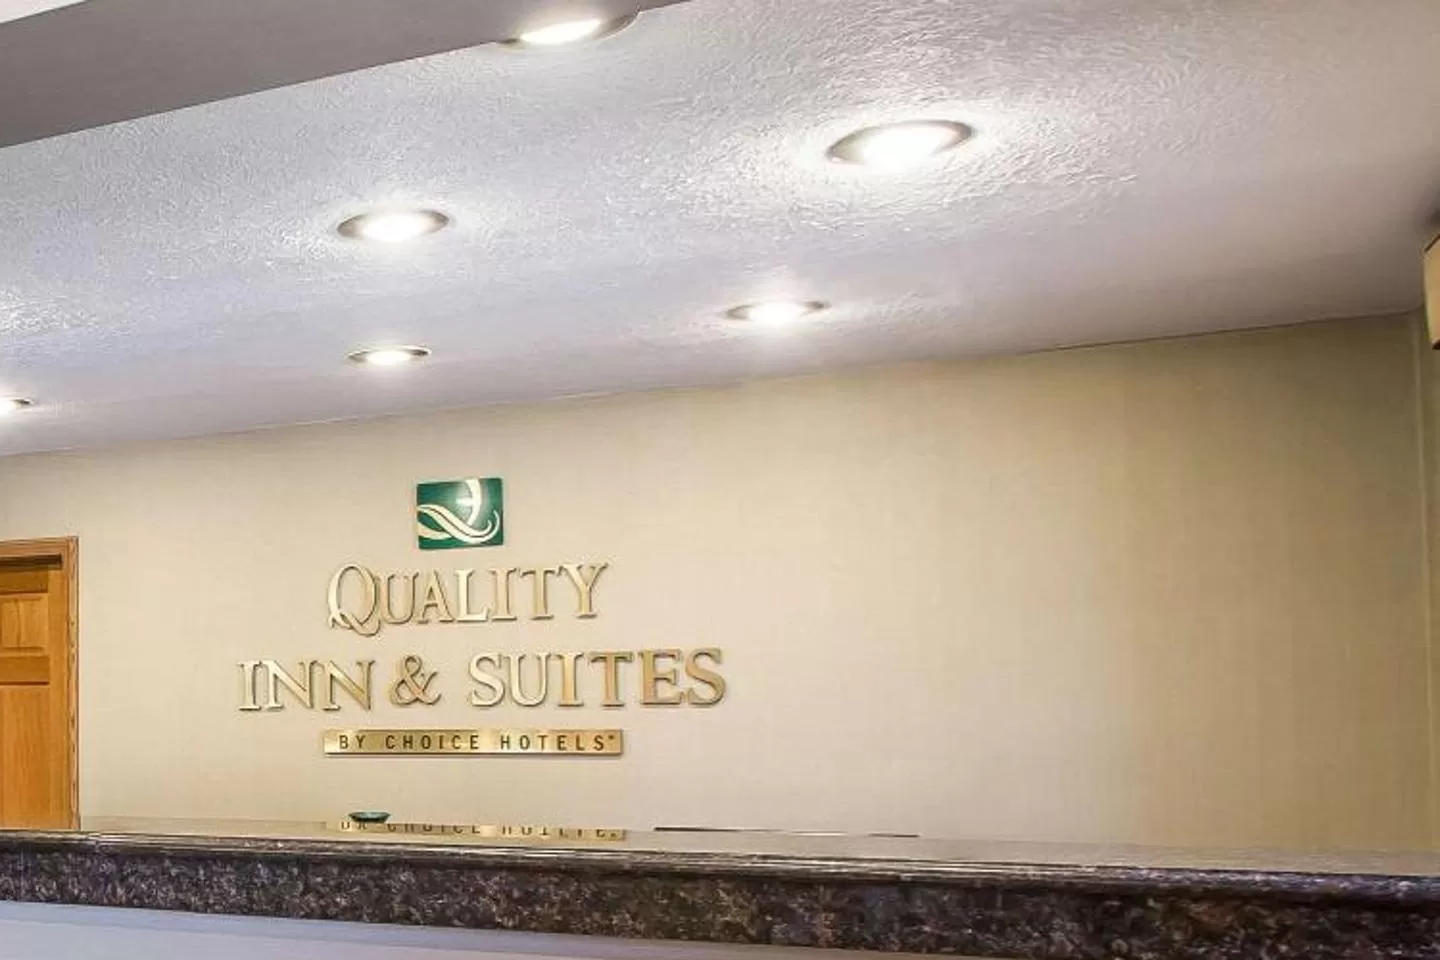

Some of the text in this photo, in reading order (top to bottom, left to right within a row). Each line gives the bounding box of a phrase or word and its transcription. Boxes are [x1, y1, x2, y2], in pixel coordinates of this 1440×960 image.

[326, 561, 609, 637] QUALITY
[237, 646, 729, 713] INN & SUITES
[338, 734, 366, 750] BY
[385, 734, 480, 750] CHOICE
